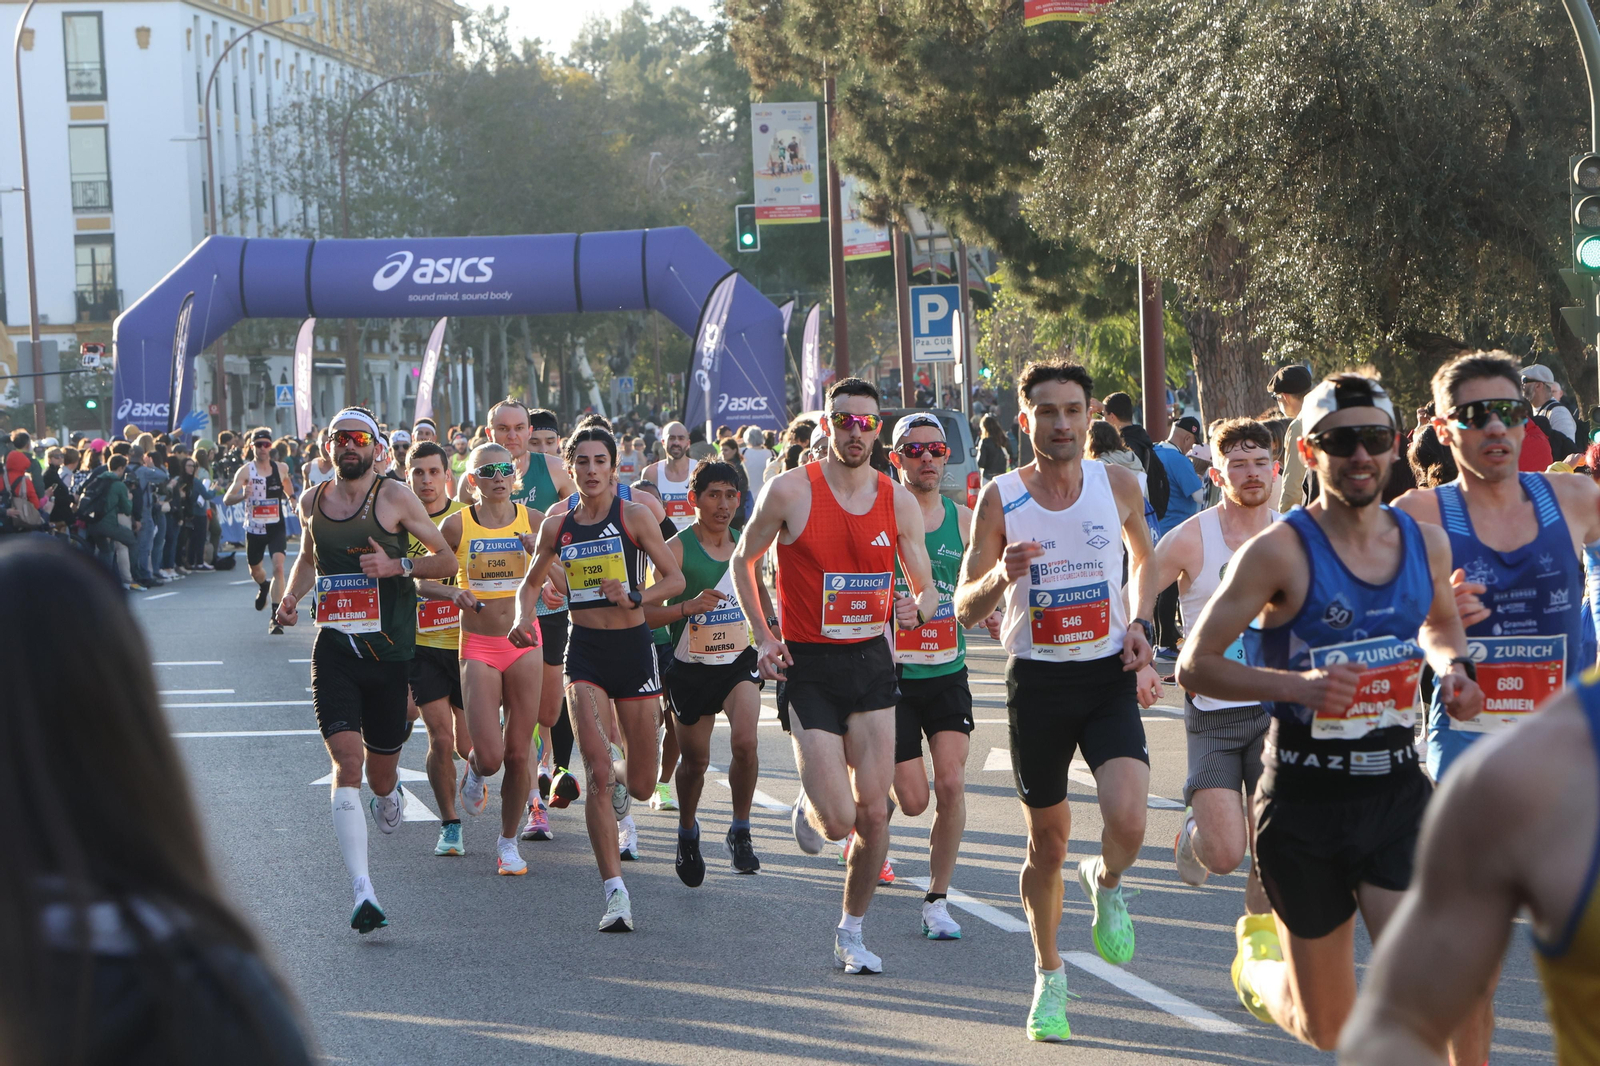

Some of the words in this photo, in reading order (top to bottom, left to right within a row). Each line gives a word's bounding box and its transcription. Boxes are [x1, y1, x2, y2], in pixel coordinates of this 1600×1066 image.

[412, 256, 495, 284] asics
[408, 292, 436, 302] sound
[436, 292, 460, 301] mind,
[462, 292, 488, 300] sound
[490, 290, 512, 300] body
[918, 294, 949, 334] P
[702, 323, 719, 370] asics
[728, 396, 768, 411] asics
[581, 543, 613, 555] ZURICH
[583, 565, 603, 575] F328
[1040, 560, 1103, 576] Biochemic
[335, 579, 369, 588] ZURICH
[850, 578, 884, 587] ZURICH
[1042, 576, 1056, 584] SALUTE
[1057, 588, 1100, 603] ZURICH
[337, 599, 352, 608] 671
[851, 600, 866, 610] 568
[328, 611, 366, 620] GUILLERMO
[437, 606, 450, 615] 677
[710, 611, 740, 622] ZURICH
[934, 606, 950, 618] RICH
[1328, 607, 1349, 624] 30
[433, 615, 458, 626] FLORIAN
[842, 614, 873, 623] TAGGART
[1062, 615, 1082, 628] 546
[713, 632, 725, 640] 221
[922, 629, 937, 638] 606
[1053, 630, 1094, 643] LORENZO
[705, 643, 735, 652] DAVERSO
[1494, 645, 1552, 659] ZURICH
[1355, 644, 1413, 664] ZURICH
[1497, 676, 1524, 691] 680
[1486, 698, 1534, 711] DAMIEN
